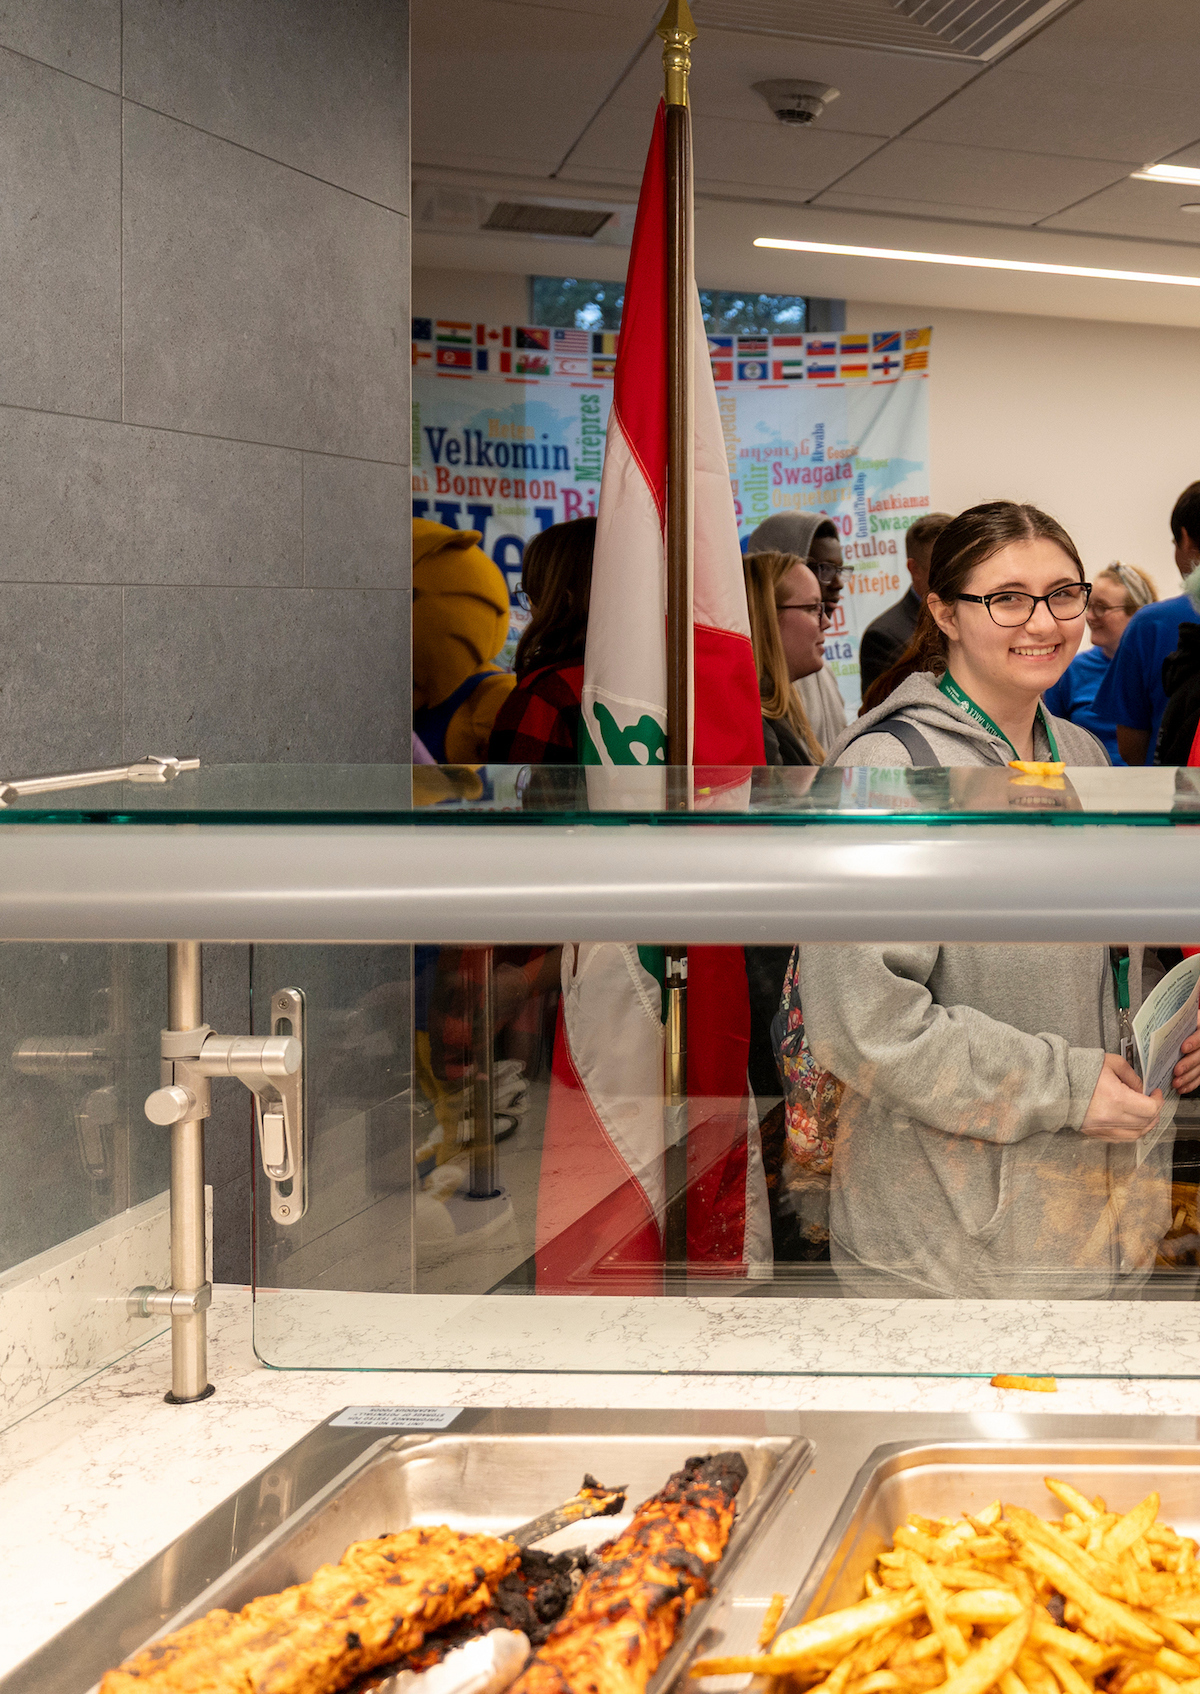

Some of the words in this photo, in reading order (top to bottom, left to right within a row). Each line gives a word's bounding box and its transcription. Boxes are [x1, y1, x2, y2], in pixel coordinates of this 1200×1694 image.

[424, 426, 570, 471] Velkomin
[435, 466, 557, 500] Bonvenon
[772, 461, 854, 489] Swagata
[743, 464, 770, 526] Acollir
[867, 493, 930, 513] Laukiamas
[824, 641, 853, 661] uta
